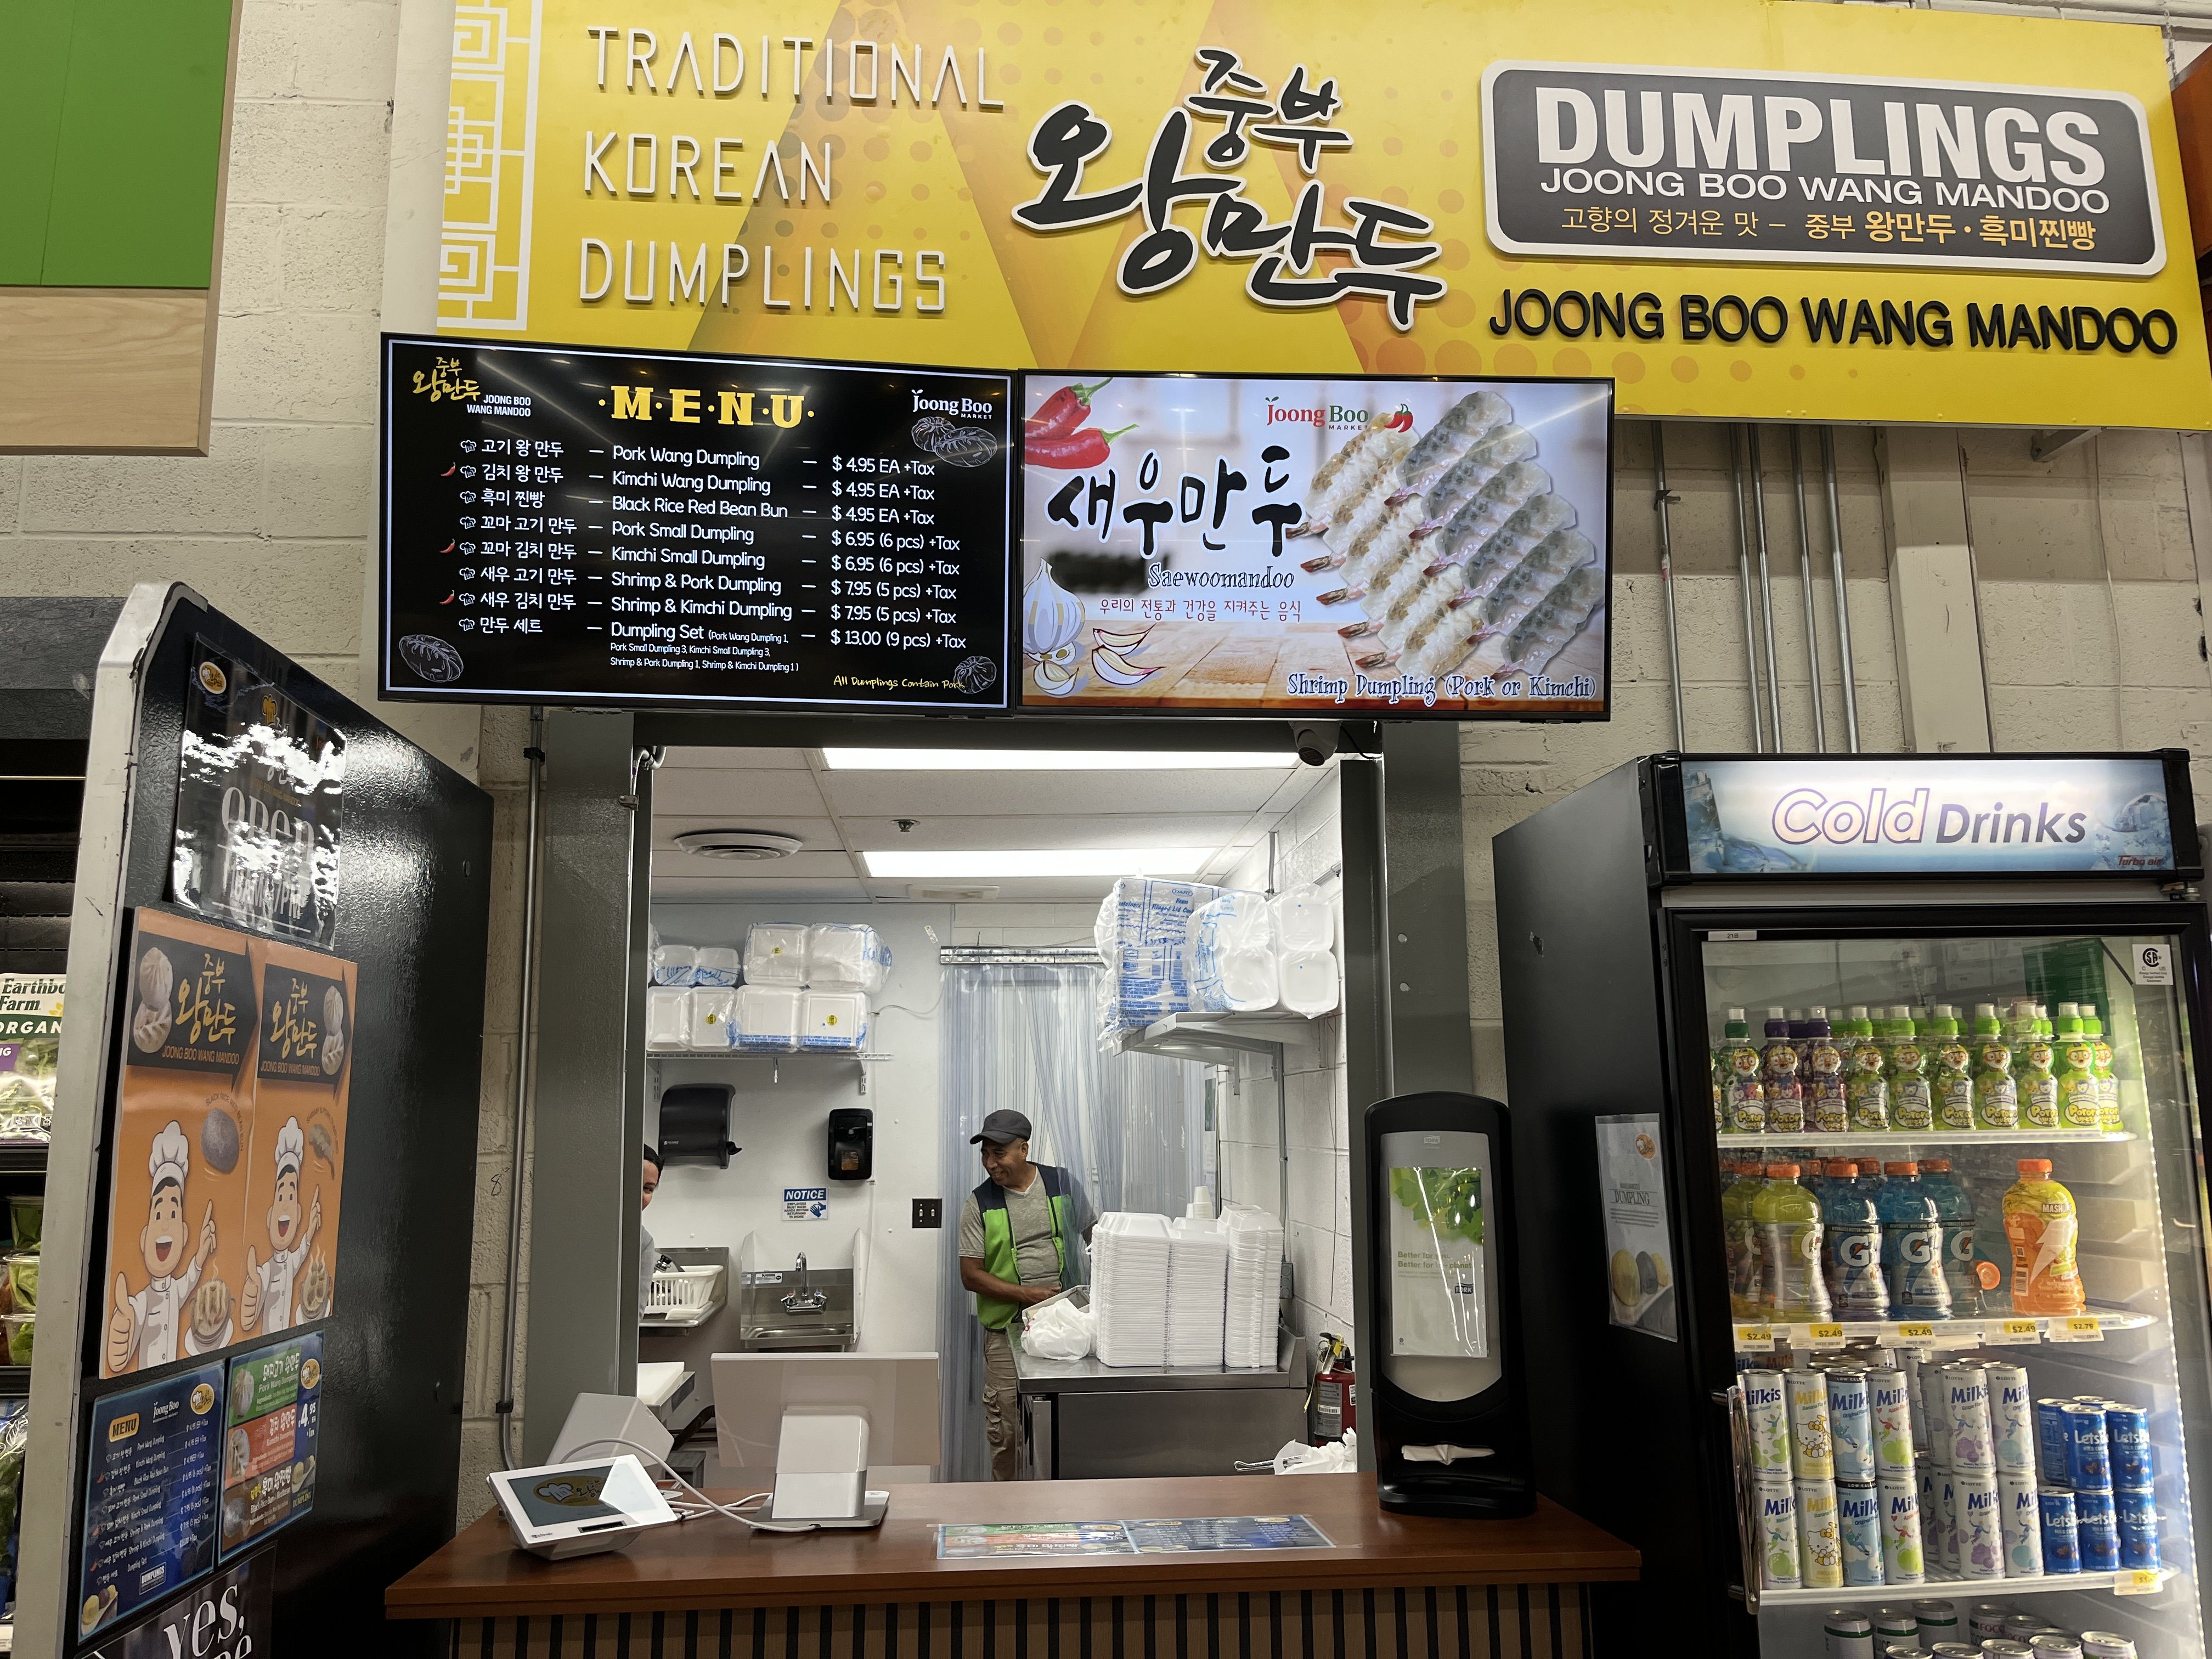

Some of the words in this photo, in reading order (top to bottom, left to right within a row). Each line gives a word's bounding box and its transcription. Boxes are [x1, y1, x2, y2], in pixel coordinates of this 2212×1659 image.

[587, 25, 1004, 109] TRADITIONAL
[1183, 46, 1354, 176] 중부
[1536, 86, 2107, 186] DUMPLINGS
[583, 131, 832, 205] KOREAN
[1541, 167, 1684, 198] JOONG
[1699, 171, 1787, 201] BOO
[1798, 176, 1920, 205] WANG
[1937, 180, 2110, 215] MANDOO
[1012, 100, 1448, 332] 왕만두
[1561, 205, 1638, 236] 고향의
[1649, 208, 1724, 238] 정겨운
[1734, 211, 1759, 238] 맛
[1805, 214, 1855, 241] 중부
[579, 238, 946, 313] DUMPLINGS
[1489, 289, 1664, 338] JOONG
[1680, 294, 1787, 343] BOO
[1801, 297, 1953, 347] WANG
[1968, 302, 2177, 355] MANDOO
[436, 357, 462, 377] 중부
[413, 370, 481, 402] 왕만두
[467, 404, 492, 415] WANG
[494, 406, 531, 417] MANDOO
[483, 394, 512, 405] JOONG
[514, 396, 531, 407] BOO
[912, 394, 959, 415] Joong
[962, 398, 992, 413] Boo
[1267, 403, 1325, 427] Joong
[1329, 405, 1369, 422] Boo
[482, 439, 510, 456] 고기
[516, 441, 531, 457] 왕
[535, 441, 563, 458] 만두
[613, 445, 646, 461] Pork
[651, 448, 692, 467] Wang
[697, 449, 759, 470] Dumpling
[482, 464, 510, 481] 김치
[516, 465, 531, 482] 왕
[535, 466, 563, 484] 만두
[832, 455, 842, 472] $
[847, 458, 875, 473] 4.95
[879, 459, 900, 473] EA
[904, 460, 935, 476] +Tax
[482, 488, 510, 507] 흑미
[515, 490, 545, 509] 찐빵
[613, 496, 650, 512] Black
[654, 498, 684, 513] Rice
[688, 500, 714, 514] Red
[720, 501, 756, 516] Bean
[761, 503, 788, 518] Bun
[1047, 445, 1302, 557] 새우만두
[832, 504, 842, 521] $
[847, 507, 875, 522] 4.95
[879, 508, 900, 523] EA
[904, 509, 934, 525] +Tax
[481, 541, 511, 557] 꼬마
[515, 542, 543, 558] 김치
[548, 543, 577, 560] 만두
[612, 546, 656, 563] Kimchi
[661, 549, 697, 564] Small
[702, 550, 765, 571] Dumpling
[832, 555, 841, 572] $
[845, 557, 875, 572] 6.95
[879, 556, 892, 573] (6
[896, 557, 924, 576] pcs)
[929, 560, 960, 575] +Tax
[1149, 563, 1294, 588] Saewoomandoo
[1100, 599, 1133, 615] 우리의
[1141, 599, 1176, 620] 전통과
[1183, 600, 1217, 622] 건강을
[1224, 601, 1270, 620] 지켜주는
[1278, 601, 1301, 622] 음식
[480, 617, 510, 635] 만두
[514, 617, 543, 635] 세트
[612, 622, 675, 642] Dumpling
[680, 625, 704, 640] Set
[708, 630, 727, 641] (Pork
[729, 633, 749, 643] Wang
[751, 633, 782, 644] Dumpling
[611, 642, 627, 651] Pork
[629, 644, 647, 652] Small
[648, 644, 680, 655] Dumpling
[689, 646, 711, 654] Kimchi
[713, 646, 731, 654] Small
[732, 646, 763, 658] Dumpling
[831, 629, 841, 646] $
[845, 630, 881, 646] 13.00
[886, 631, 900, 648] (9
[904, 633, 930, 650] pcs)
[935, 635, 966, 649] +Tax
[834, 675, 848, 686] All
[851, 677, 898, 690] Dumplings
[902, 678, 939, 687] Contain
[1288, 674, 1348, 703] Shrimp
[1356, 675, 1436, 706] Dumpling
[1446, 676, 1494, 697] (Pork
[1503, 681, 1521, 696] or
[1530, 676, 1595, 698] Kimchi)
[1772, 788, 1931, 845] Cold
[1936, 802, 2087, 843] Drinks
[162, 1045, 182, 1058] JOONG
[184, 1047, 196, 1060] BOO
[198, 1049, 215, 1062] WANG
[216, 1052, 239, 1065] MANDOO
[261, 1061, 277, 1073] JOONG
[278, 1062, 287, 1073] BOO
[786, 1190, 824, 1200] NOTICE
[1615, 1190, 1650, 1205] DUMPLING
[169, 1401, 179, 1411] Boo
[112, 1418, 137, 1437] MENU
[163, 1584, 244, 1659] yes,
